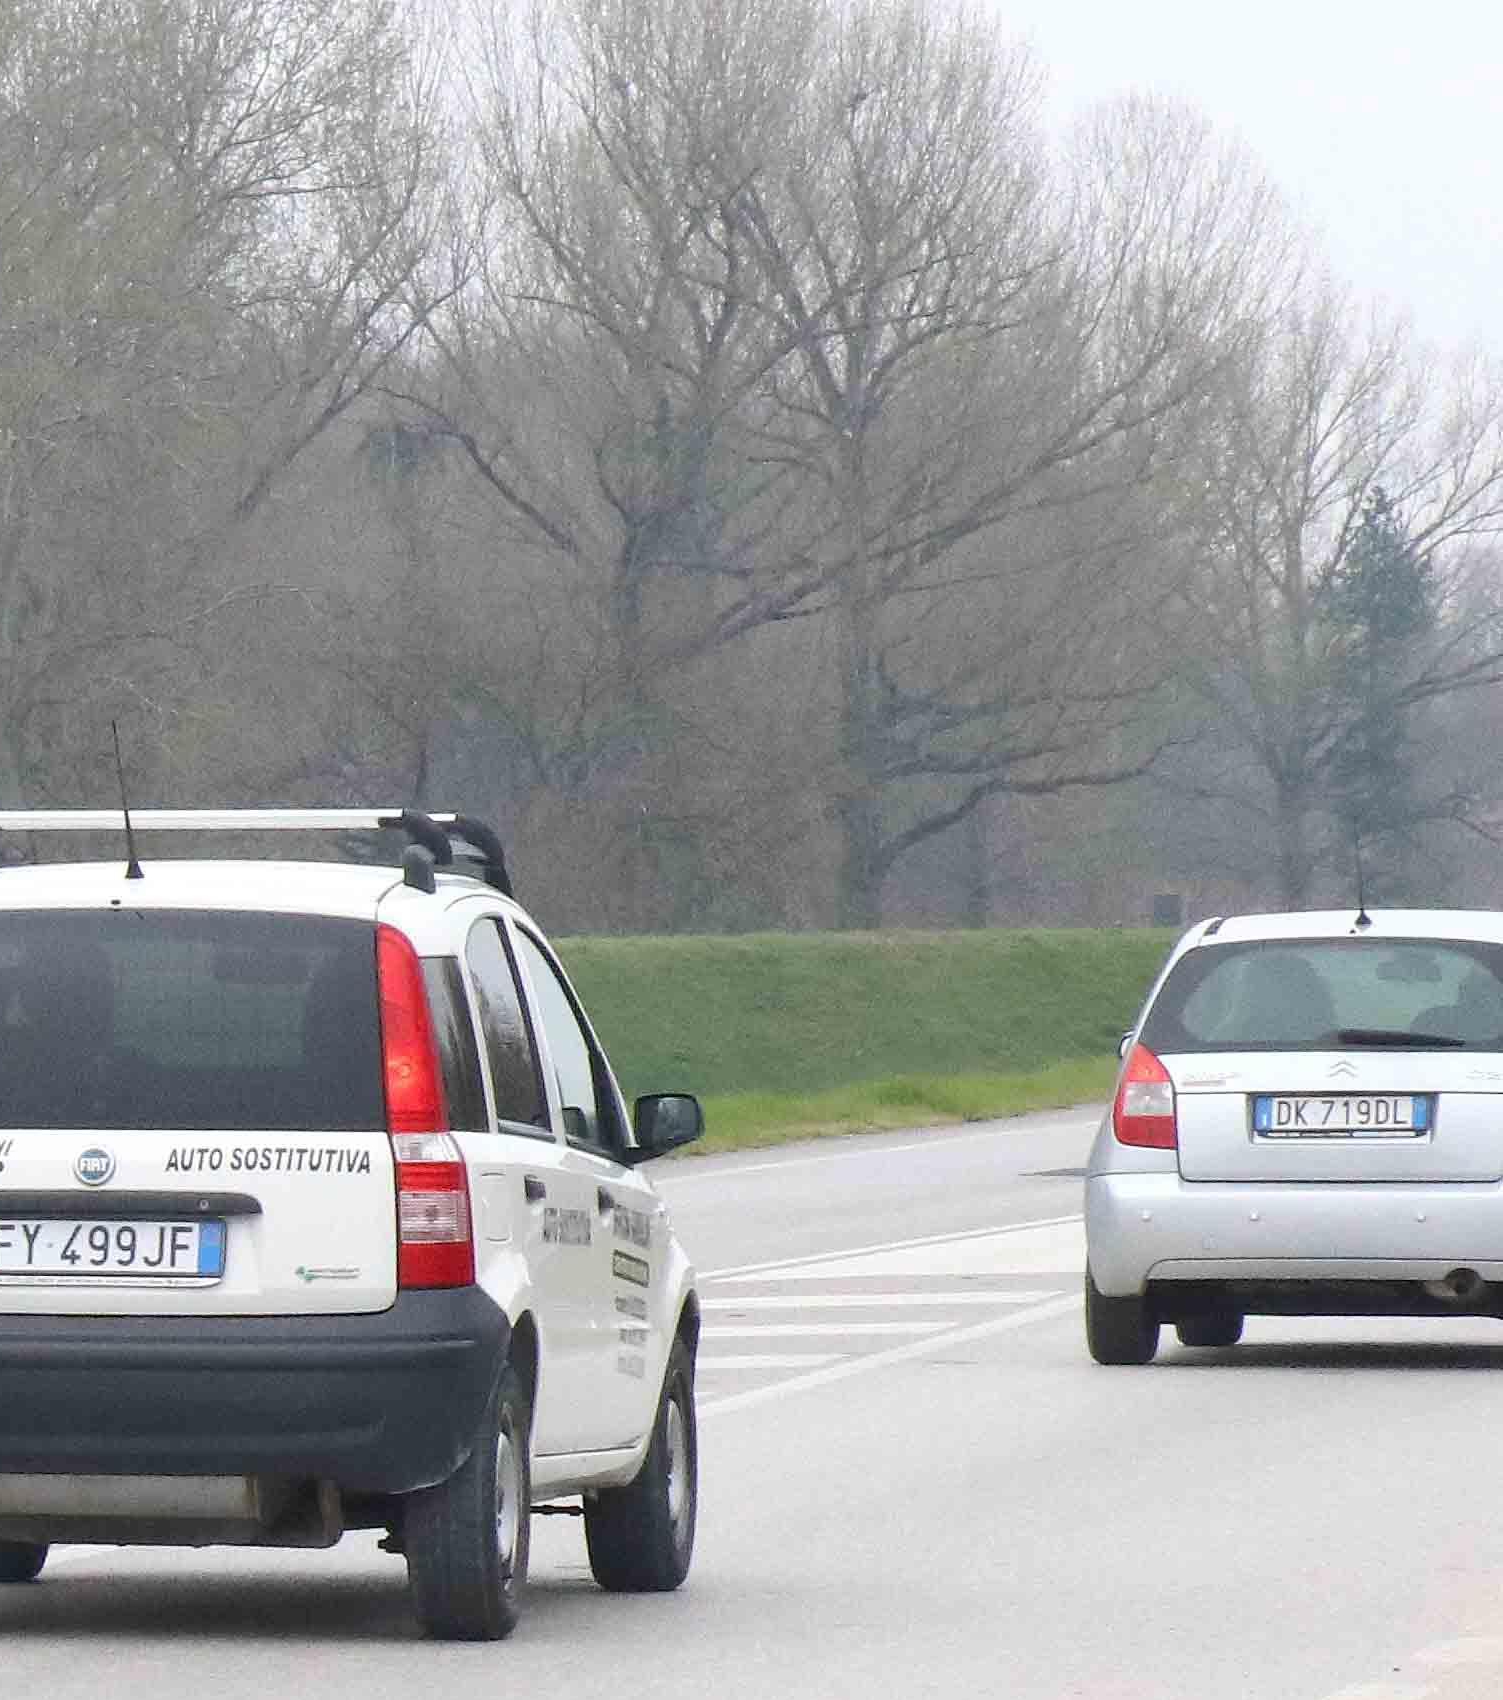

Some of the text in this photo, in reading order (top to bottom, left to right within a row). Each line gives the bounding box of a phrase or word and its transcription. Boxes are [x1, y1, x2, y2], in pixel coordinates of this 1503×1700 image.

[1277, 1100, 1408, 1126] DK 719DL
[80, 1157, 109, 1171] FIAT
[165, 1148, 371, 1174] AUTO SOSTITUTIVA
[60, 1224, 193, 1267] 499JF
